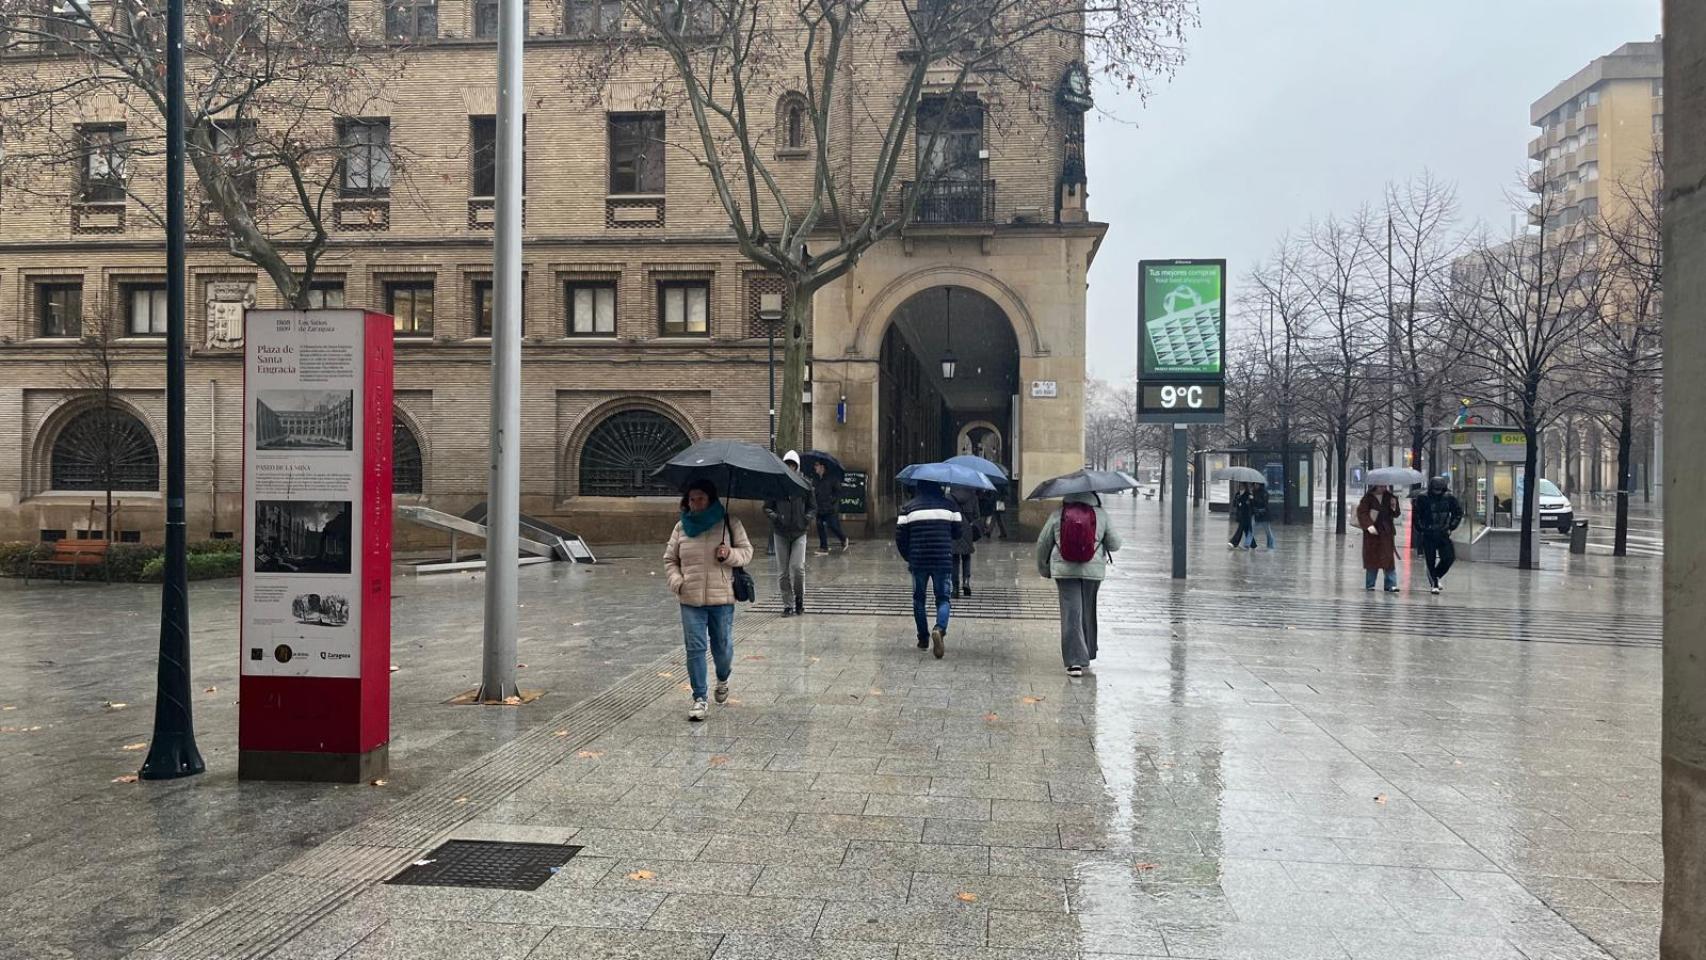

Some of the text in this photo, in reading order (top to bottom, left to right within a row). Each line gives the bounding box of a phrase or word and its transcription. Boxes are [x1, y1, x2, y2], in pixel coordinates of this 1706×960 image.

[1161, 270, 1187, 278] mejores
[257, 345, 294, 354] Plaza de
[257, 355, 283, 364] Santa
[257, 365, 296, 375] Engracia
